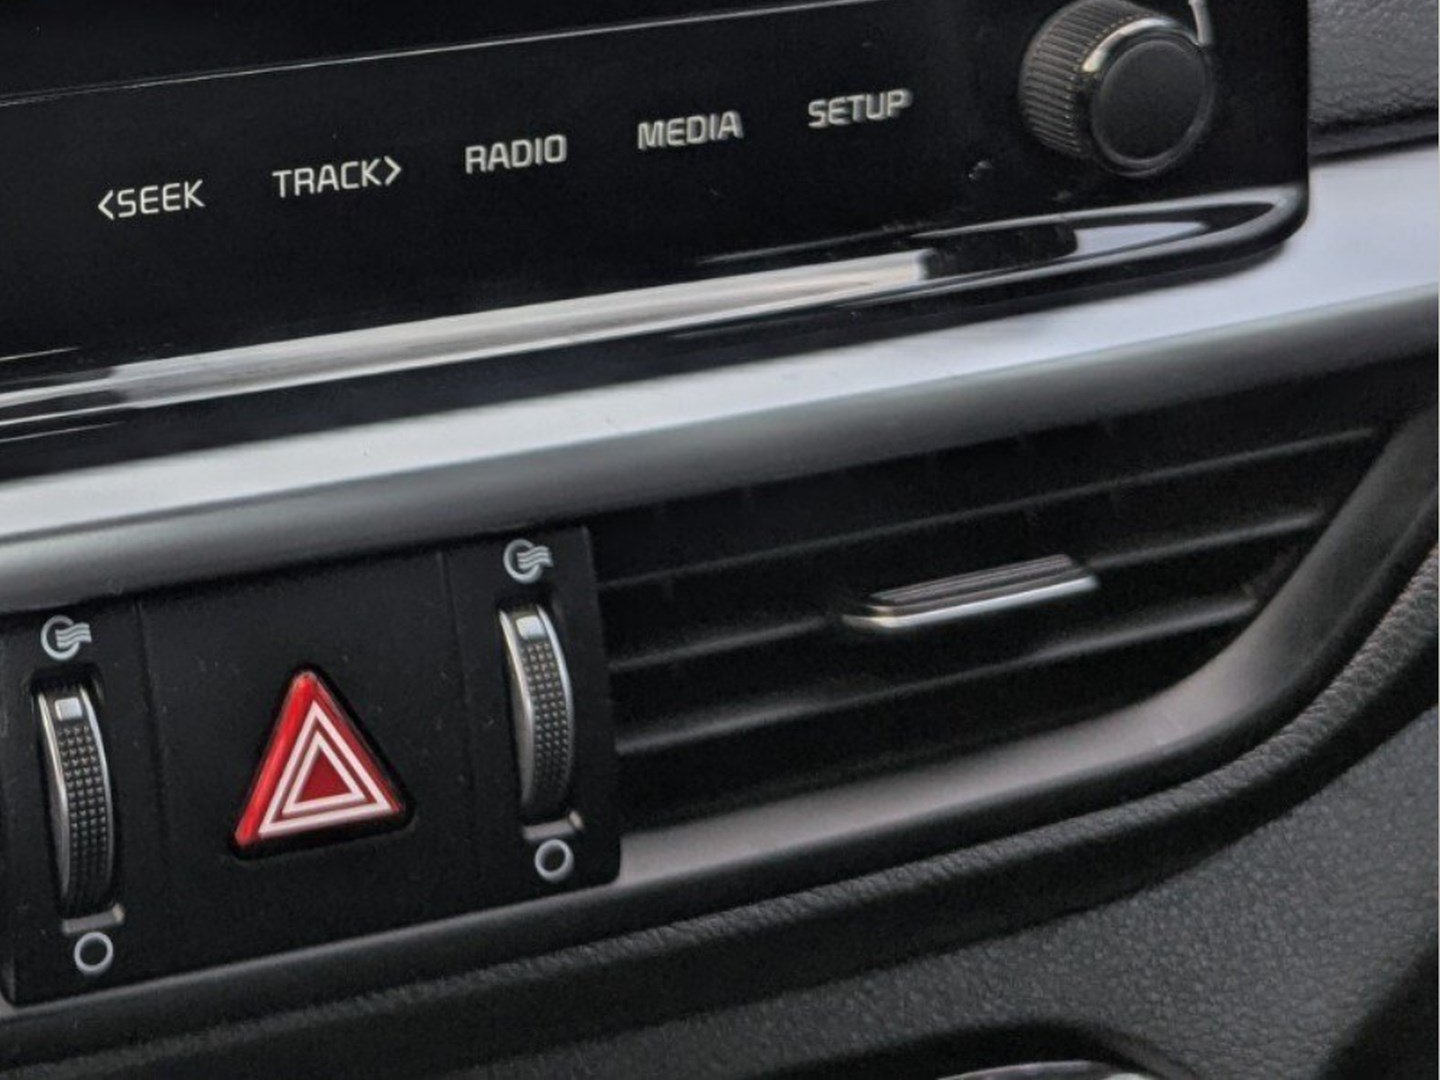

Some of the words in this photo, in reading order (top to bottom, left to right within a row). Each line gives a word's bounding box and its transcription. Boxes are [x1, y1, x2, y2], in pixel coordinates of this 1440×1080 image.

[807, 87, 912, 129] SETUP
[636, 110, 744, 151] MEDIA
[464, 134, 568, 175] RADIO
